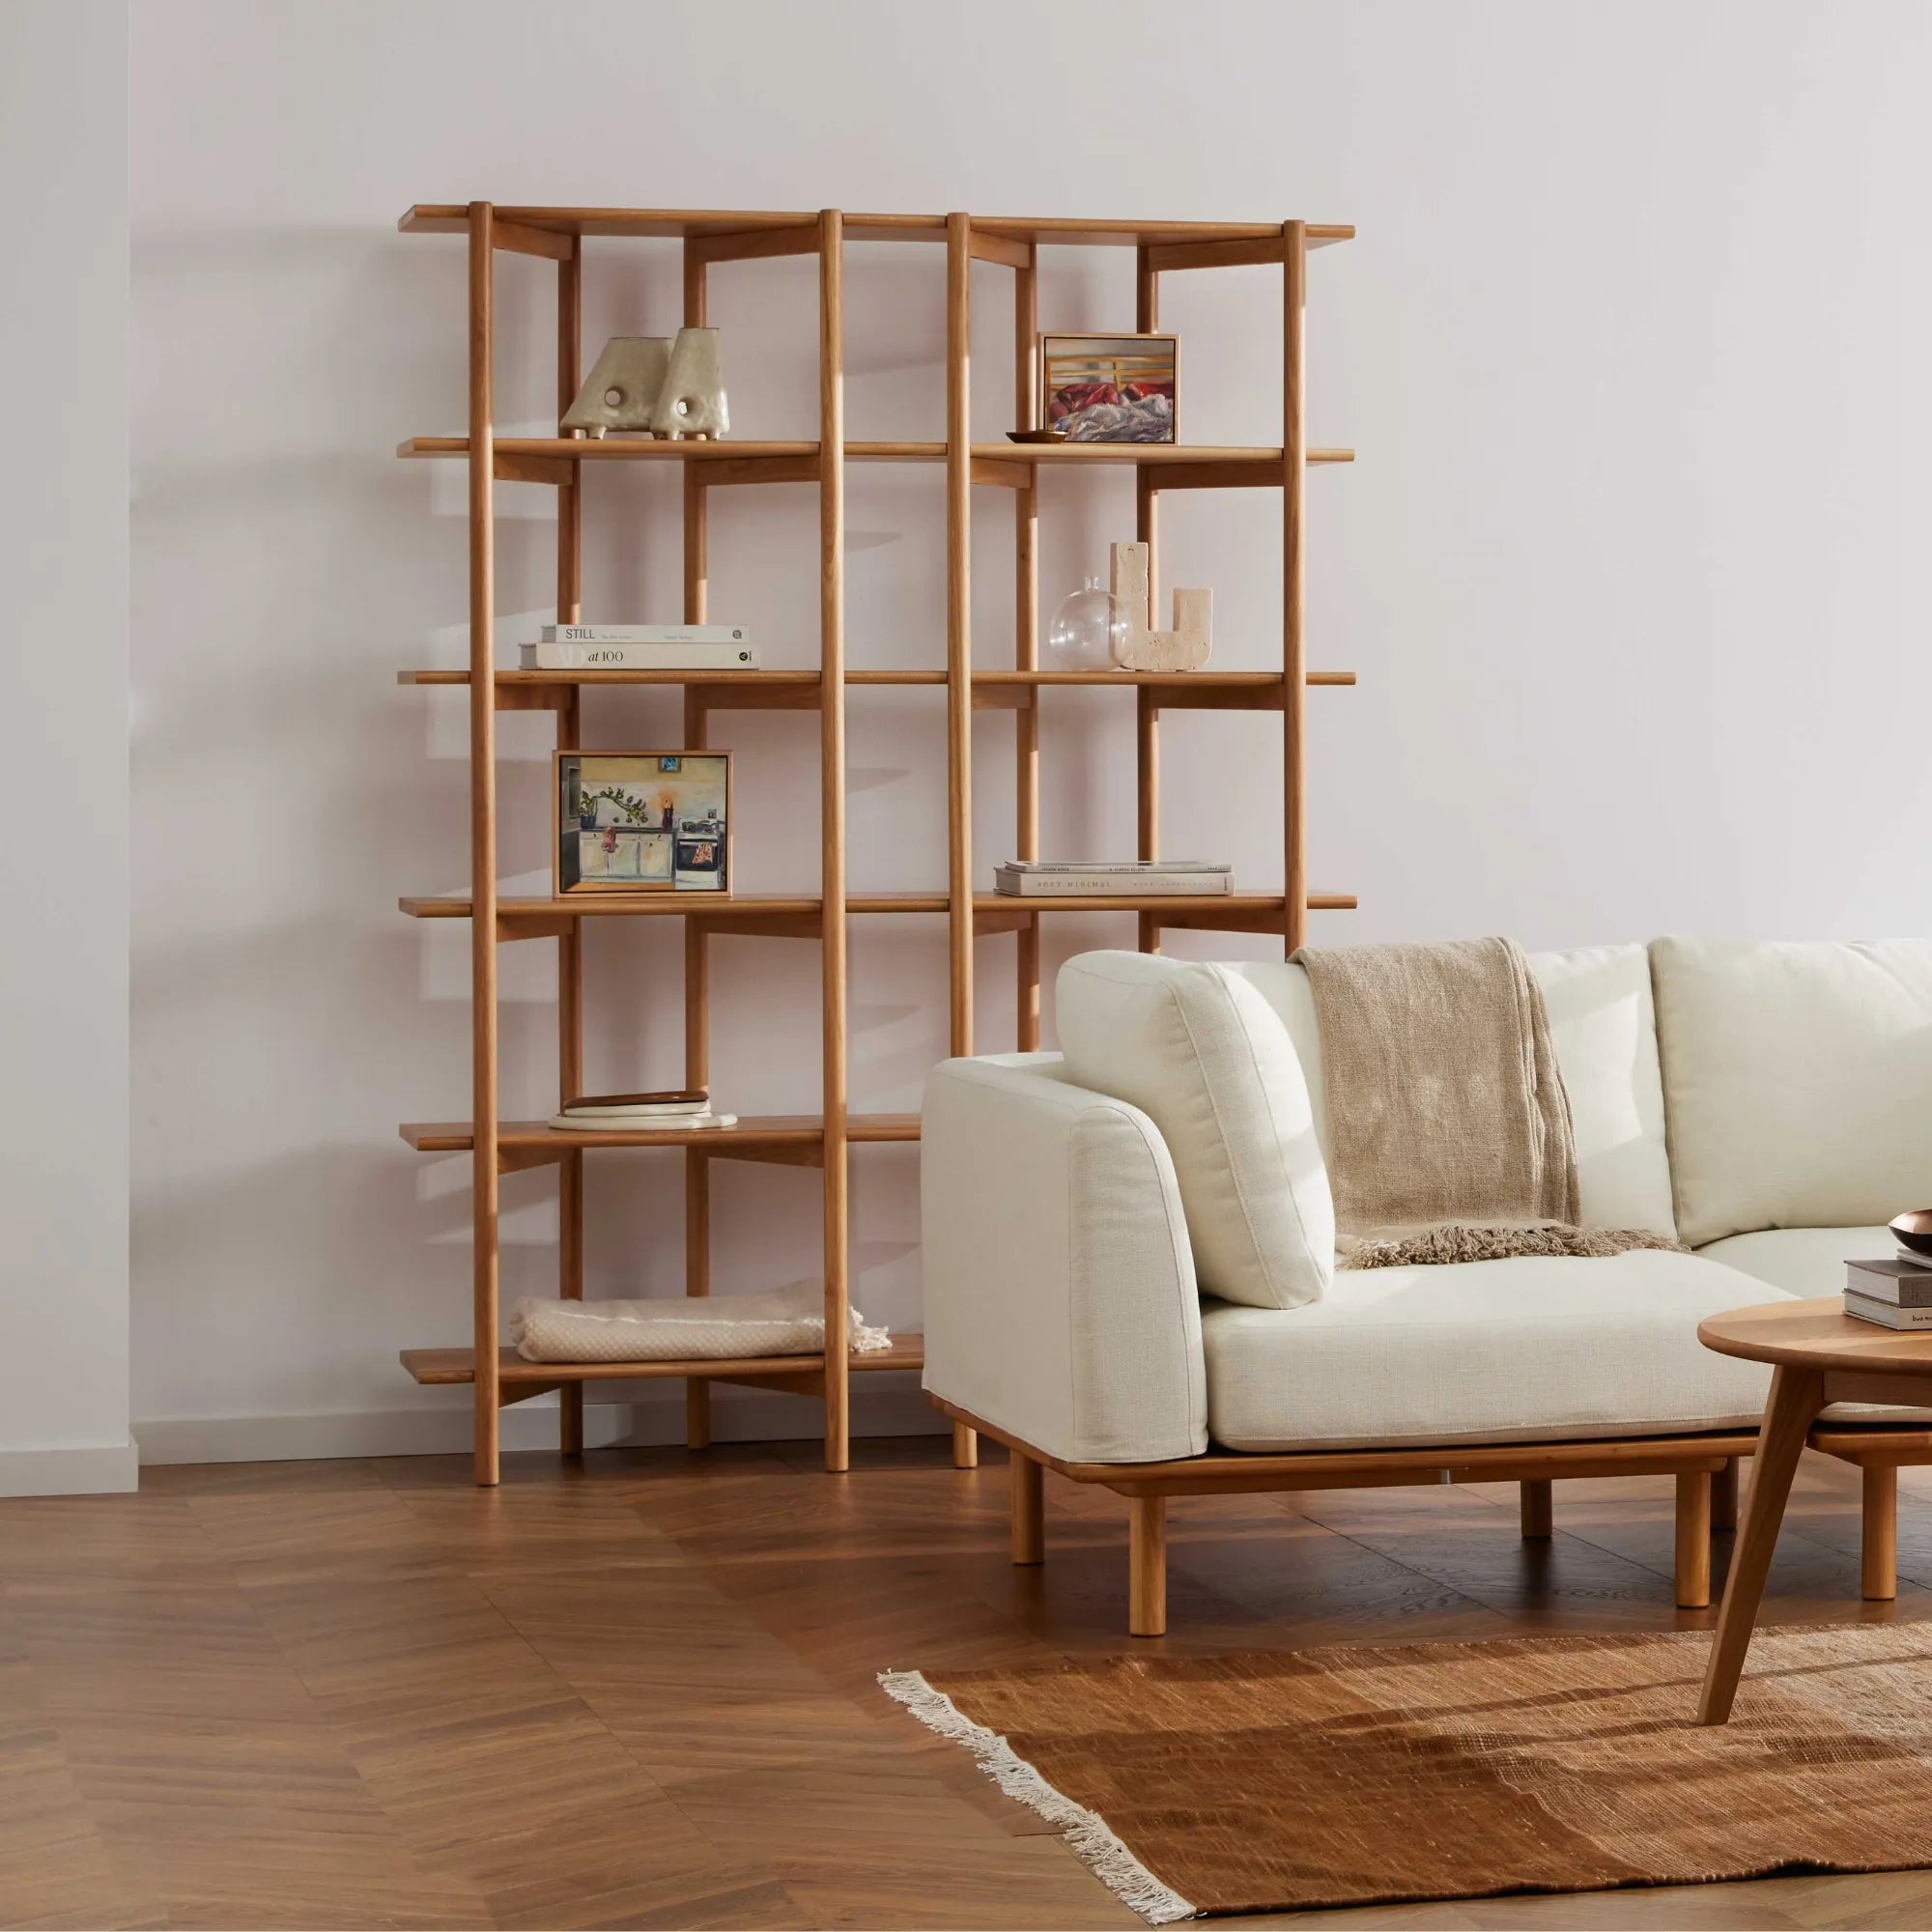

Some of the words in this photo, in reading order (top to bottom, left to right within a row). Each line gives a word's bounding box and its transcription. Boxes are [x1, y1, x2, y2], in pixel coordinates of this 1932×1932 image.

[565, 628, 596, 639] STILL
[587, 651, 599, 662] at
[602, 650, 624, 662] 100
